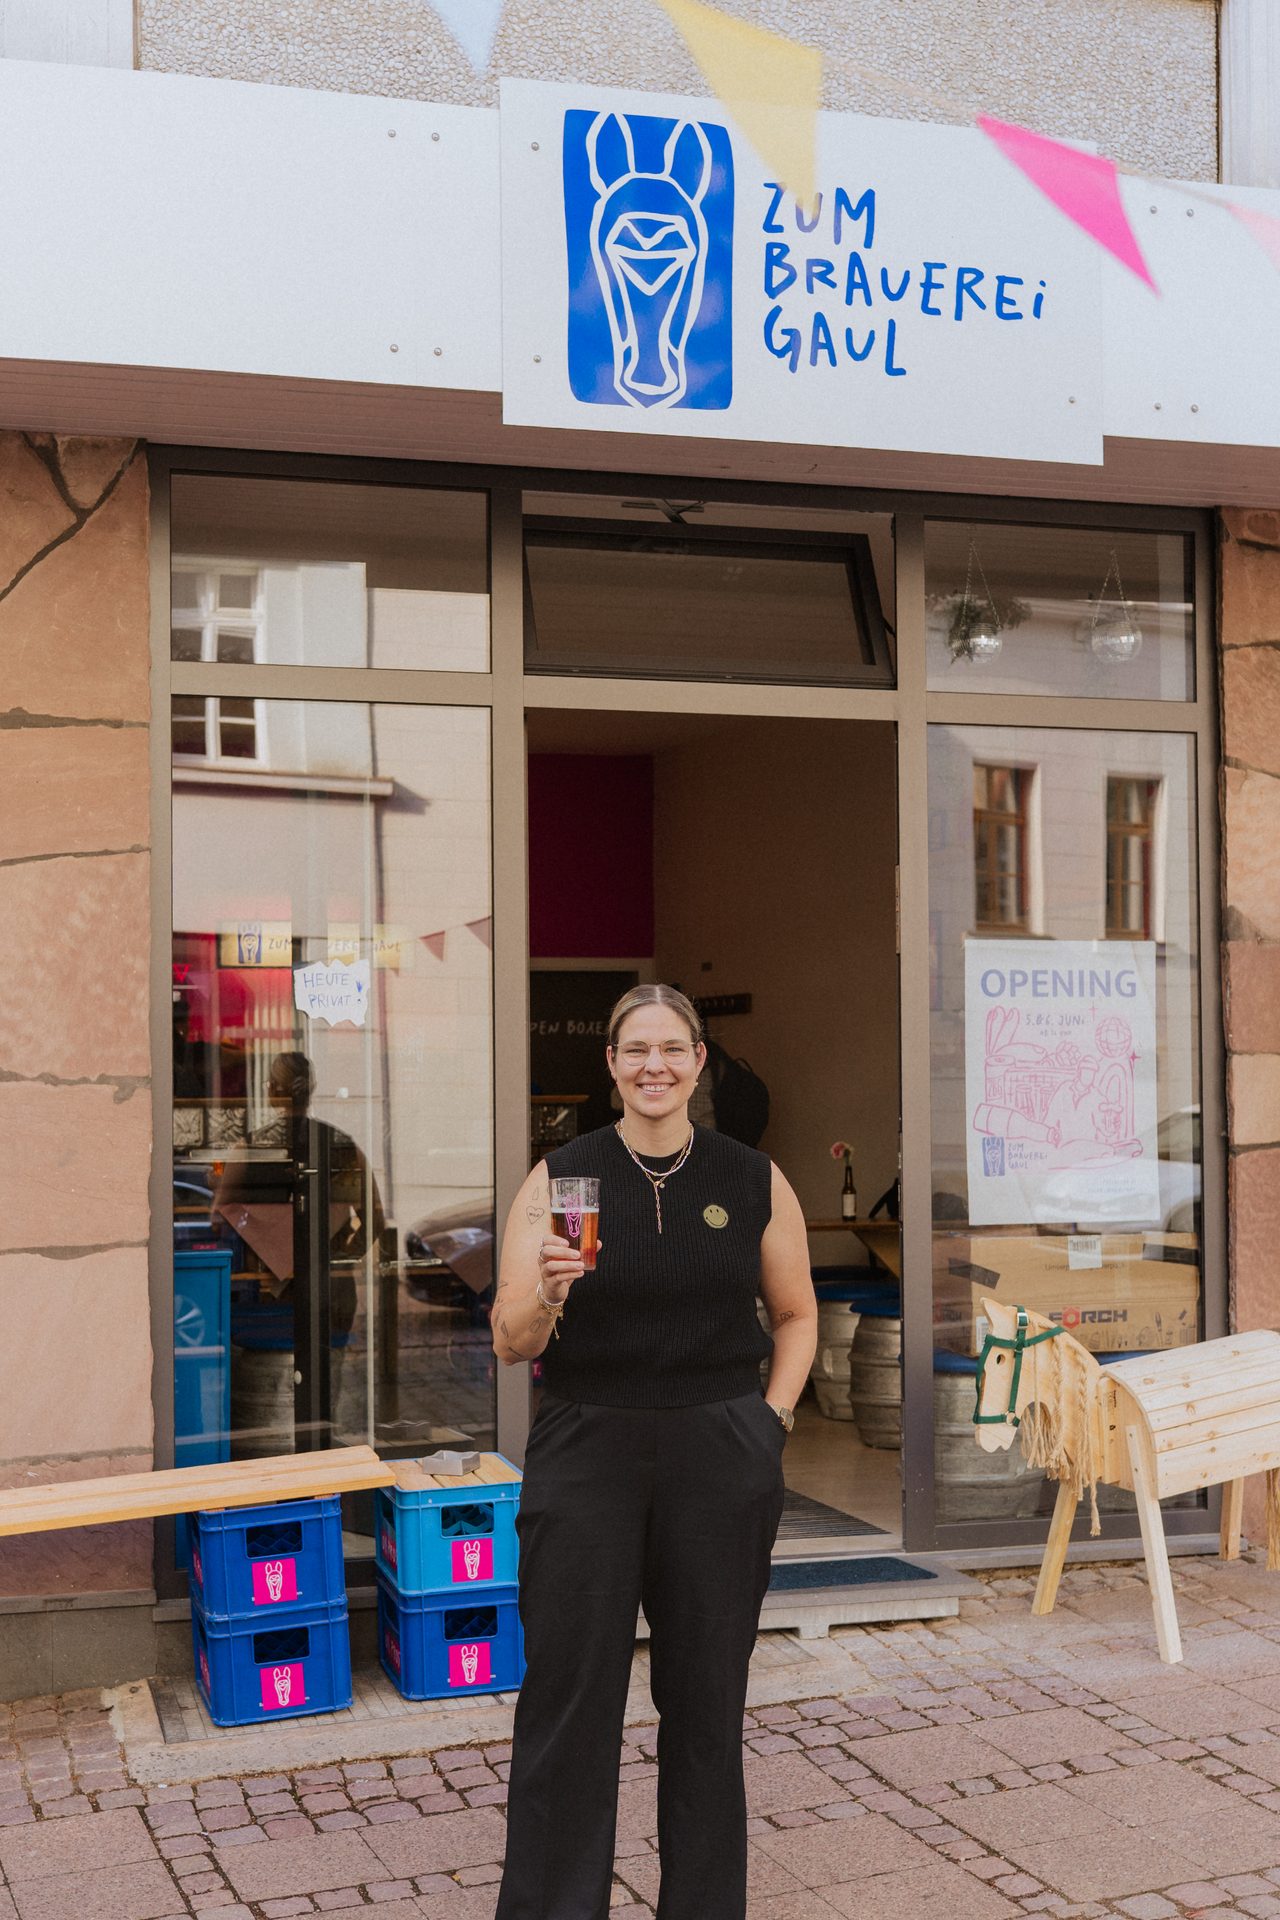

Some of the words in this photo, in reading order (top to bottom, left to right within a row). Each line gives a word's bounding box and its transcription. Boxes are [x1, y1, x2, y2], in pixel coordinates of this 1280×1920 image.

[763, 182, 876, 250] ZUM
[763, 304, 907, 376] GAUL
[303, 972, 350, 988] HEUTE
[980, 968, 1137, 998] OPENING
